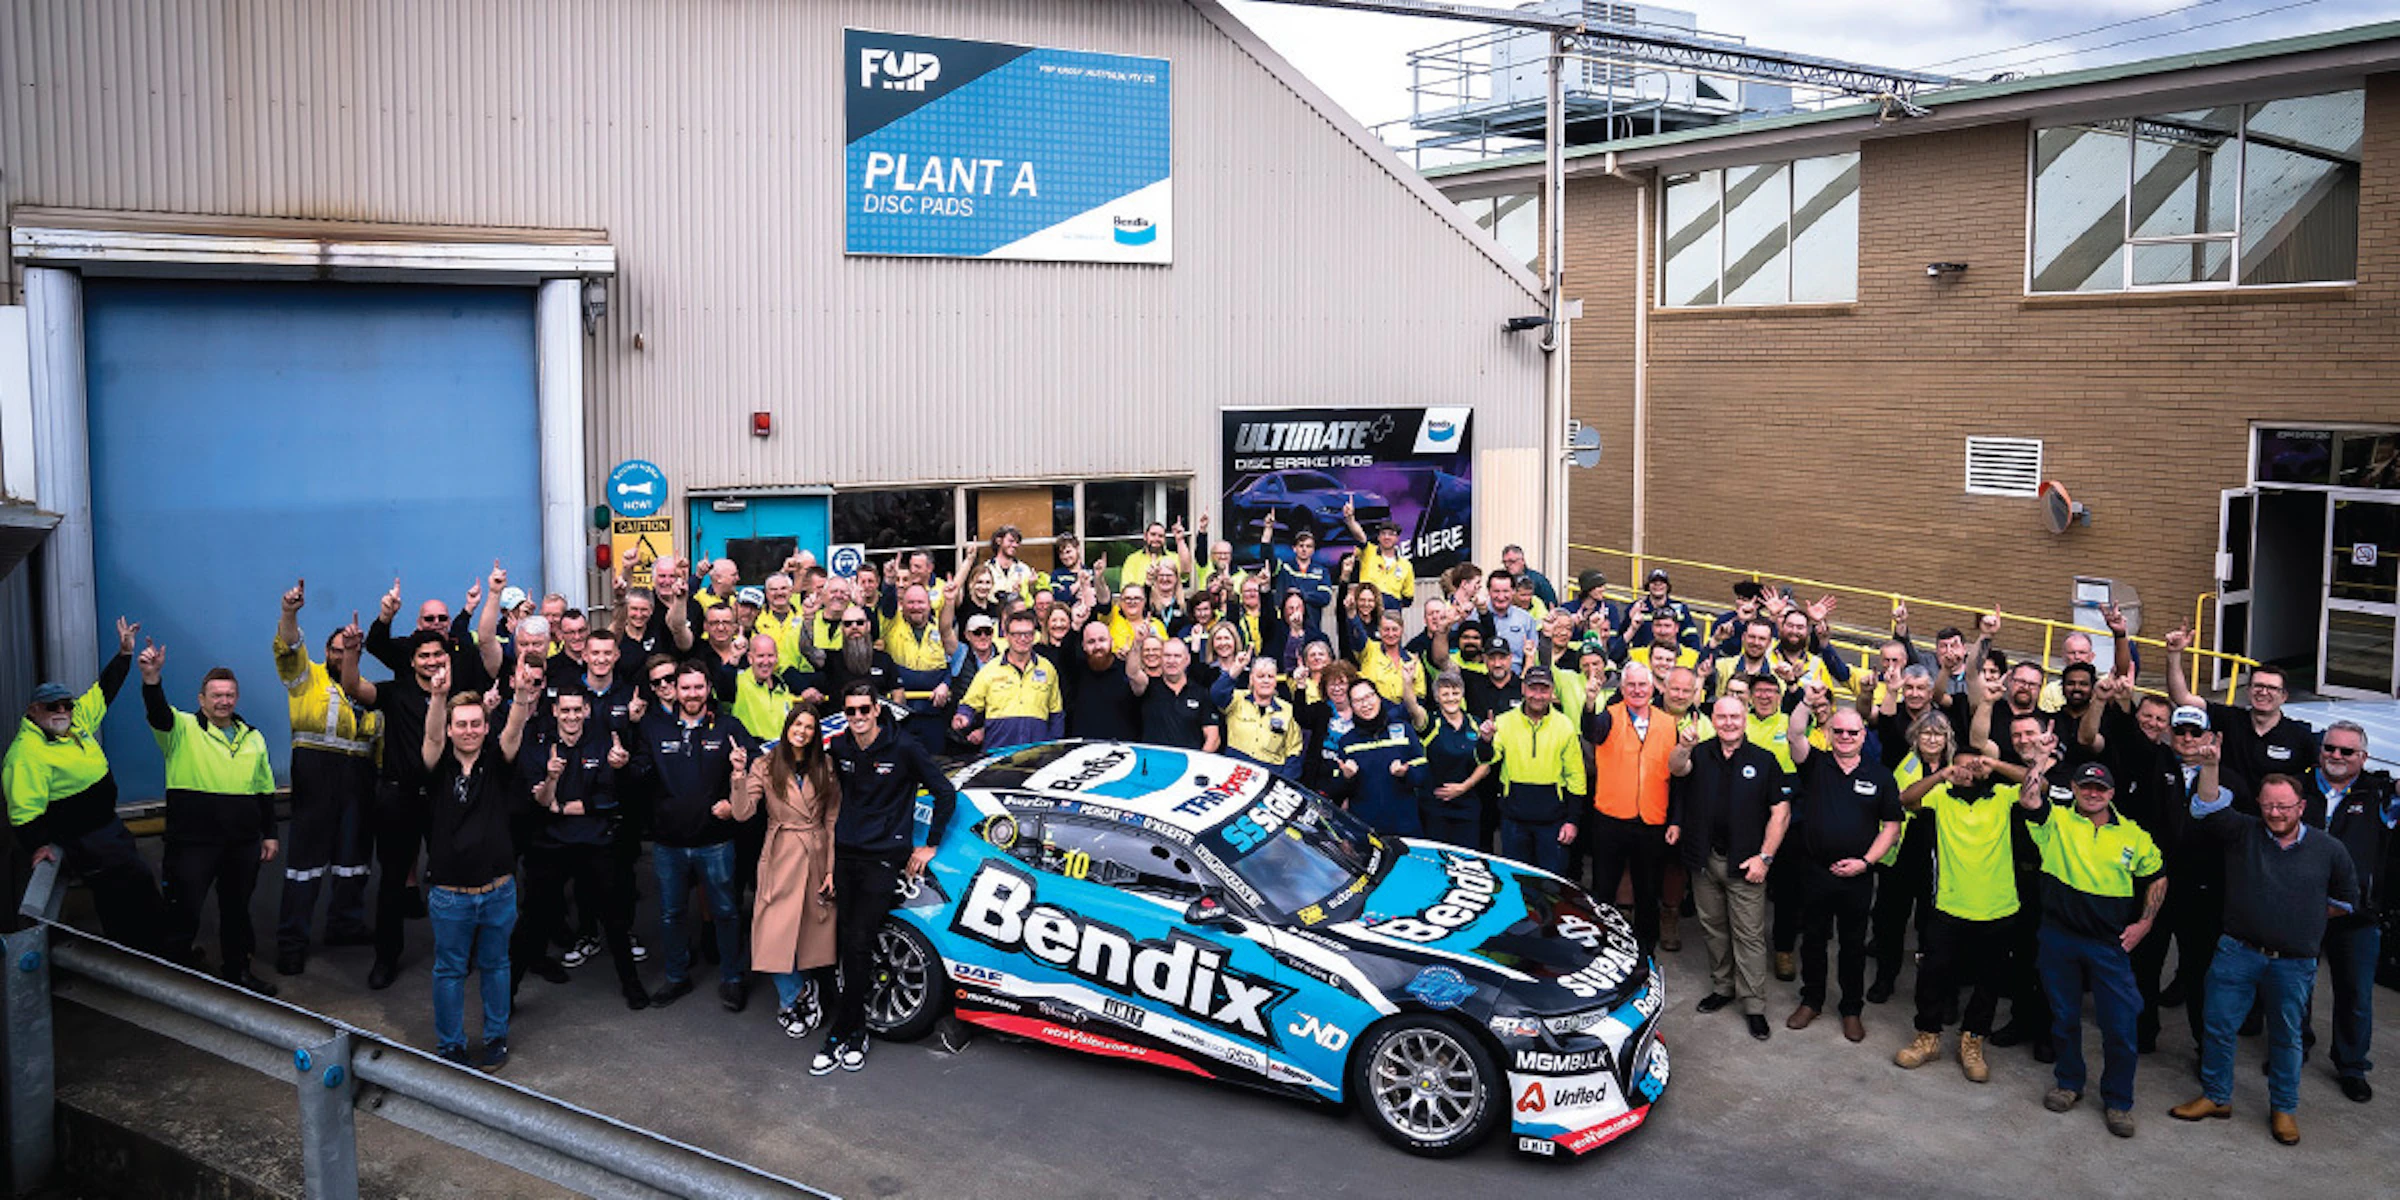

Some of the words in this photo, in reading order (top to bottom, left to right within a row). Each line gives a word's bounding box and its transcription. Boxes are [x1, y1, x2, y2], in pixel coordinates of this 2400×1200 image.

[861, 48, 941, 91] FMP
[864, 152, 1003, 195] PLANT
[1009, 161, 1038, 197] A
[864, 193, 914, 213] DISC
[920, 197, 974, 217] PADS
[1235, 456, 1271, 471] DISC
[1273, 456, 1329, 470] BRAKE
[1331, 454, 1374, 468] PADS
[618, 519, 669, 534] CAUTION
[1417, 524, 1464, 558] HERE
[1048, 749, 1131, 792] Bendix
[1078, 804, 1123, 821] PERCAT
[1142, 816, 1196, 847] O'KEEFFE
[1063, 850, 1090, 880] 10
[1376, 851, 1495, 943] Bendix
[958, 862, 1277, 1040] Bendix
[954, 963, 1003, 981] DAF
[1287, 1008, 1350, 1052] JND
[1553, 1081, 1607, 1107] United
